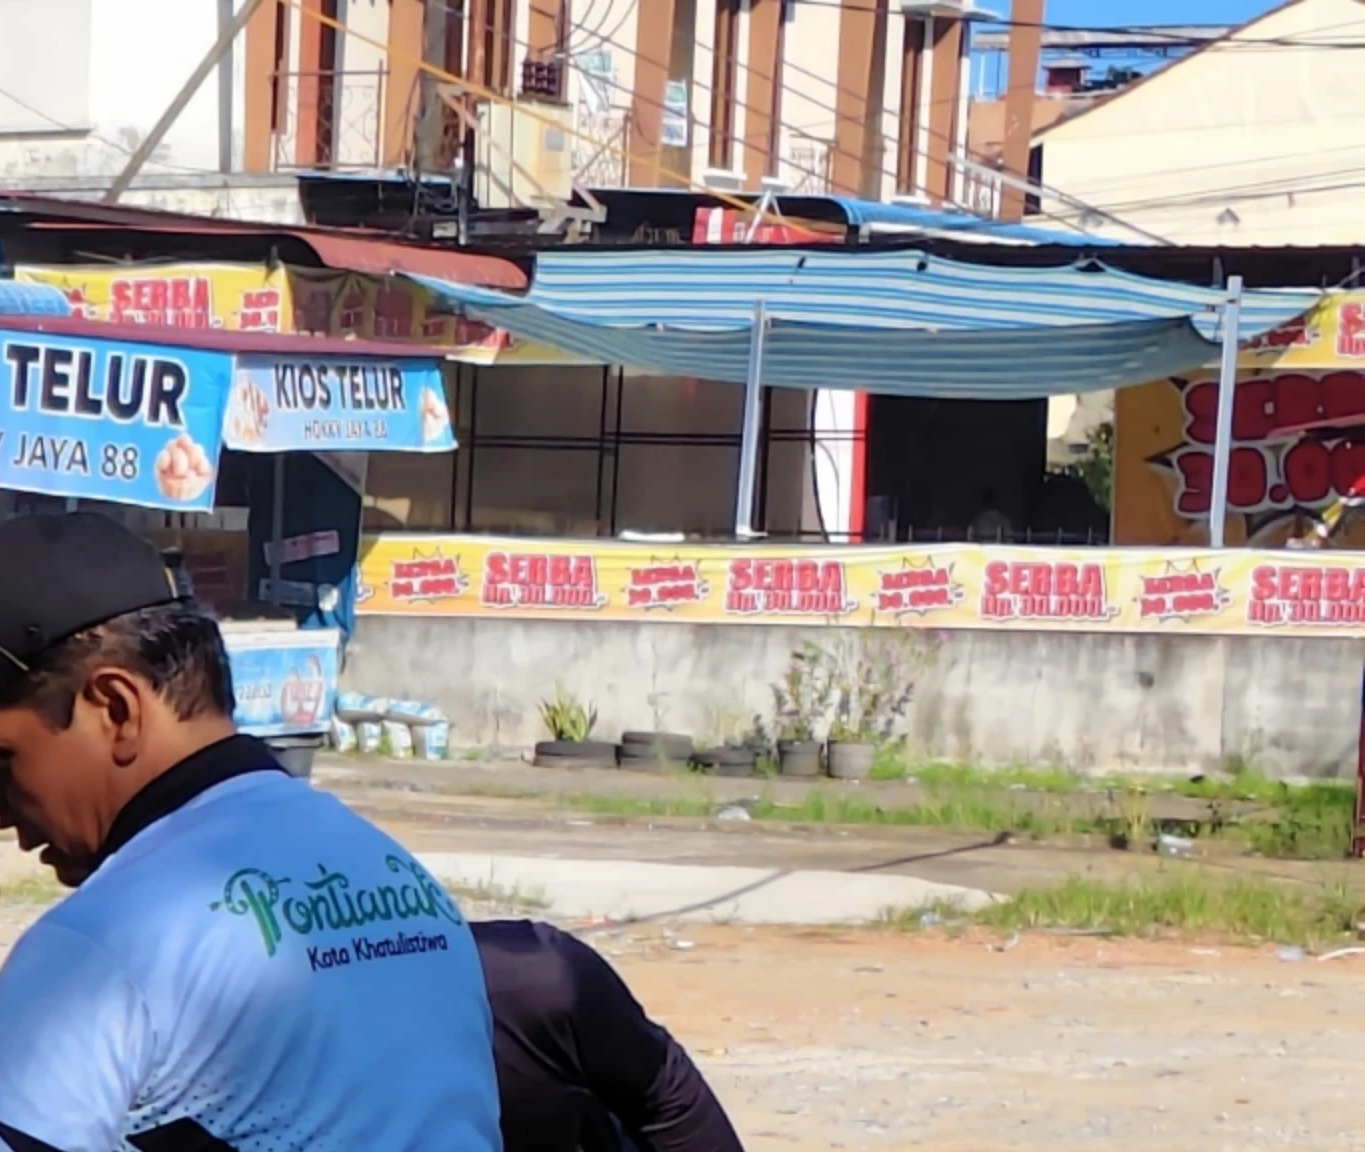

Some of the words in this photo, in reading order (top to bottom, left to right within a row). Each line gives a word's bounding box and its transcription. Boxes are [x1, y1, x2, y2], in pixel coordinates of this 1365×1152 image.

[111, 278, 210, 311] SERBA
[5, 343, 187, 426] TELUR
[274, 363, 332, 410] KIOS
[334, 364, 406, 411] TELUR
[12, 435, 89, 474] JAYA
[100, 443, 140, 480] 88
[487, 552, 594, 585] SERBA
[730, 558, 842, 591] SERBA
[984, 560, 1103, 595] SERBA
[1251, 565, 1365, 600] SERBA
[209, 853, 463, 958] Pontianak
[306, 946, 351, 973] Kota
